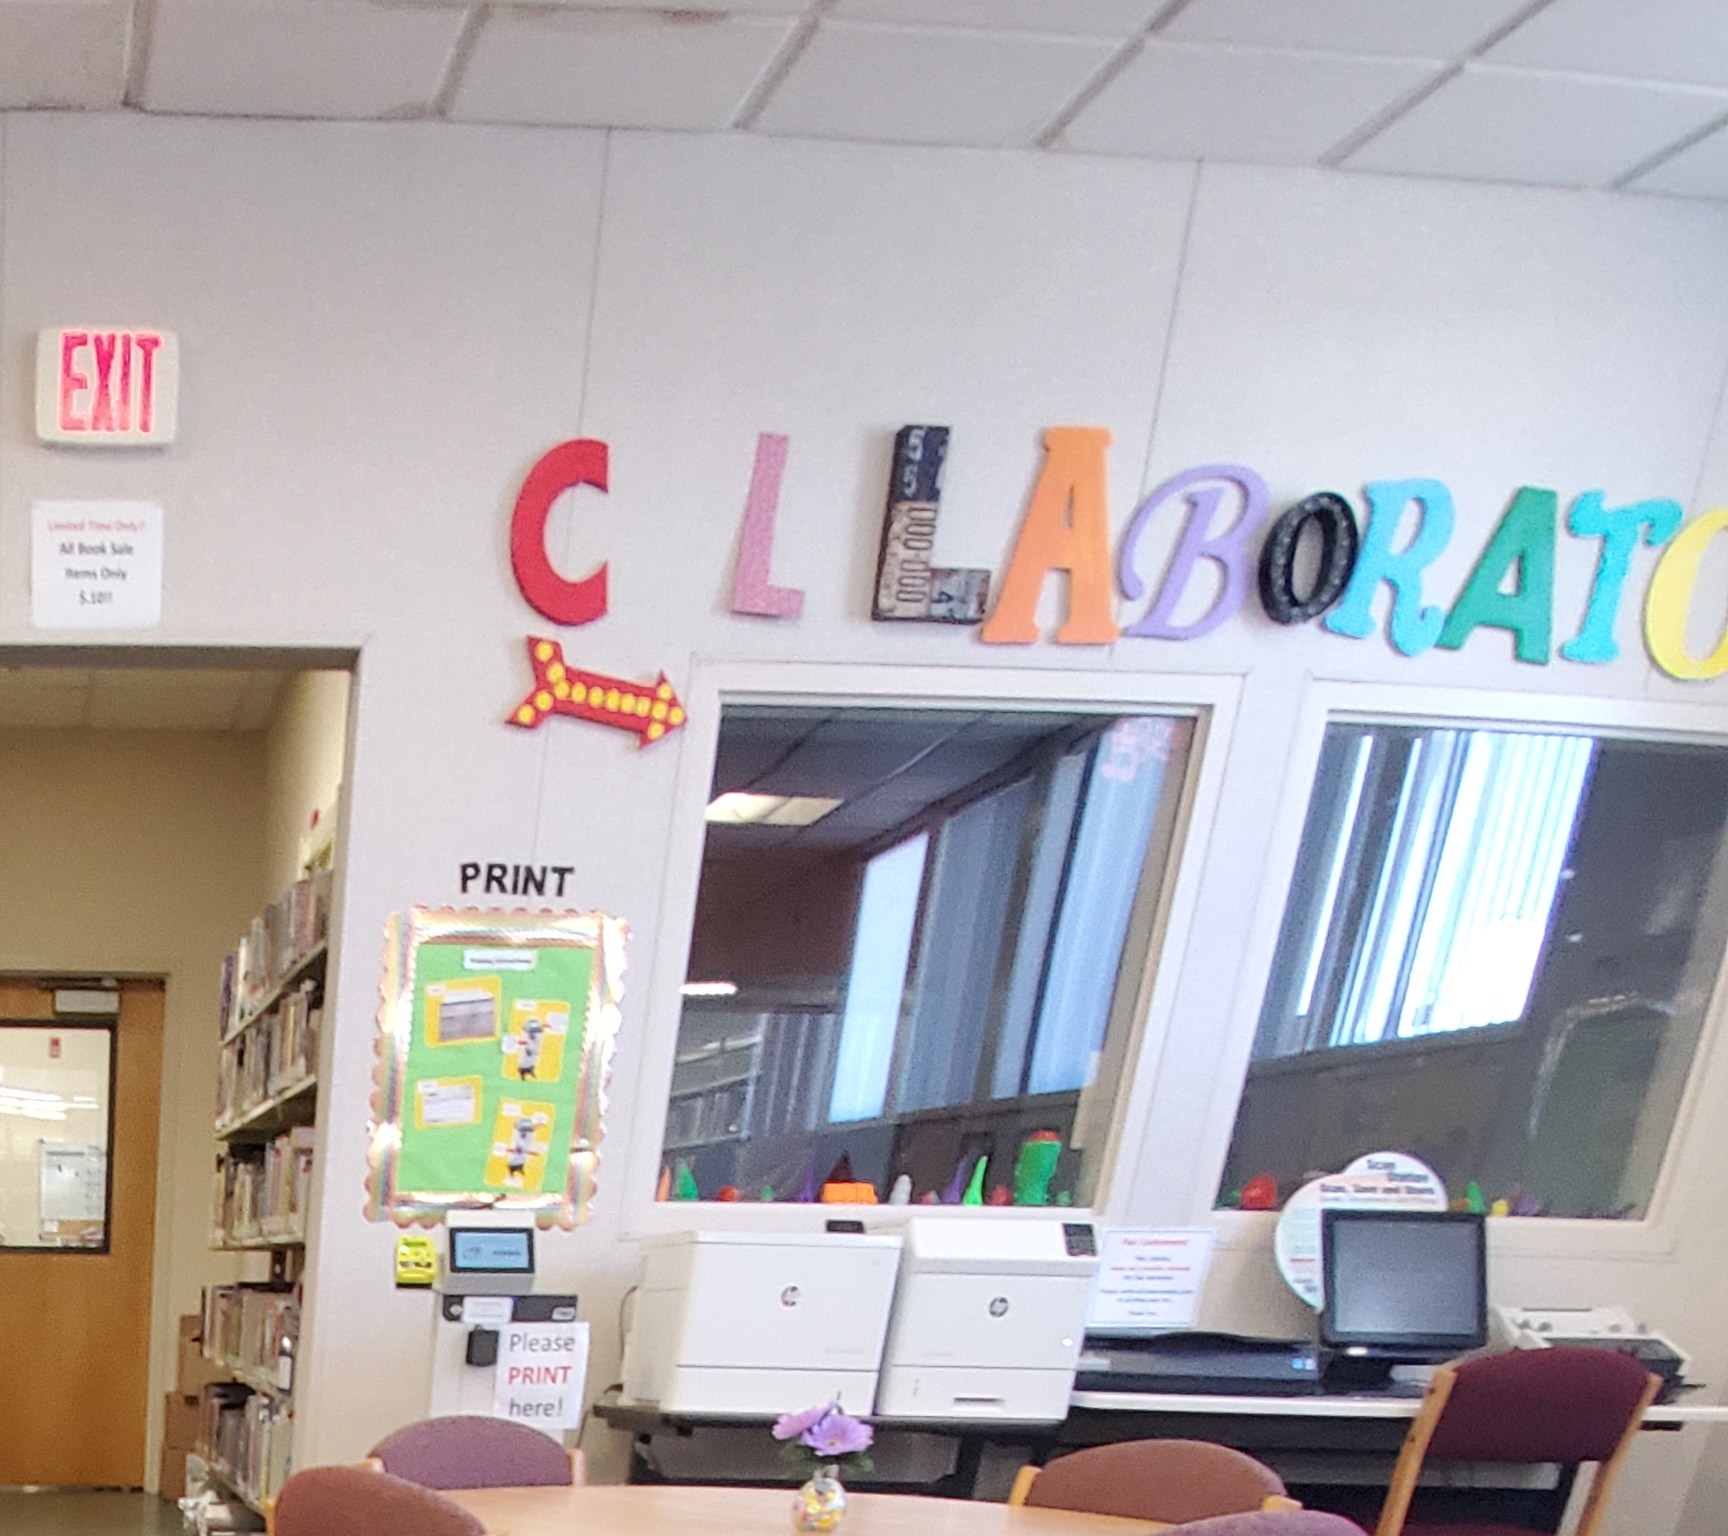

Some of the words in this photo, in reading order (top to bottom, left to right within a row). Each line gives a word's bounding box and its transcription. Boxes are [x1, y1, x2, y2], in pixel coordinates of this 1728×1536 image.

[60, 332, 162, 432] EXIT
[59, 542, 74, 555] All
[77, 542, 106, 555] Book
[110, 542, 134, 555] Sale
[459, 862, 575, 898] PRINT
[509, 1333, 576, 1353] Please
[508, 1366, 572, 1385] PRINT
[509, 1398, 565, 1418] here!
